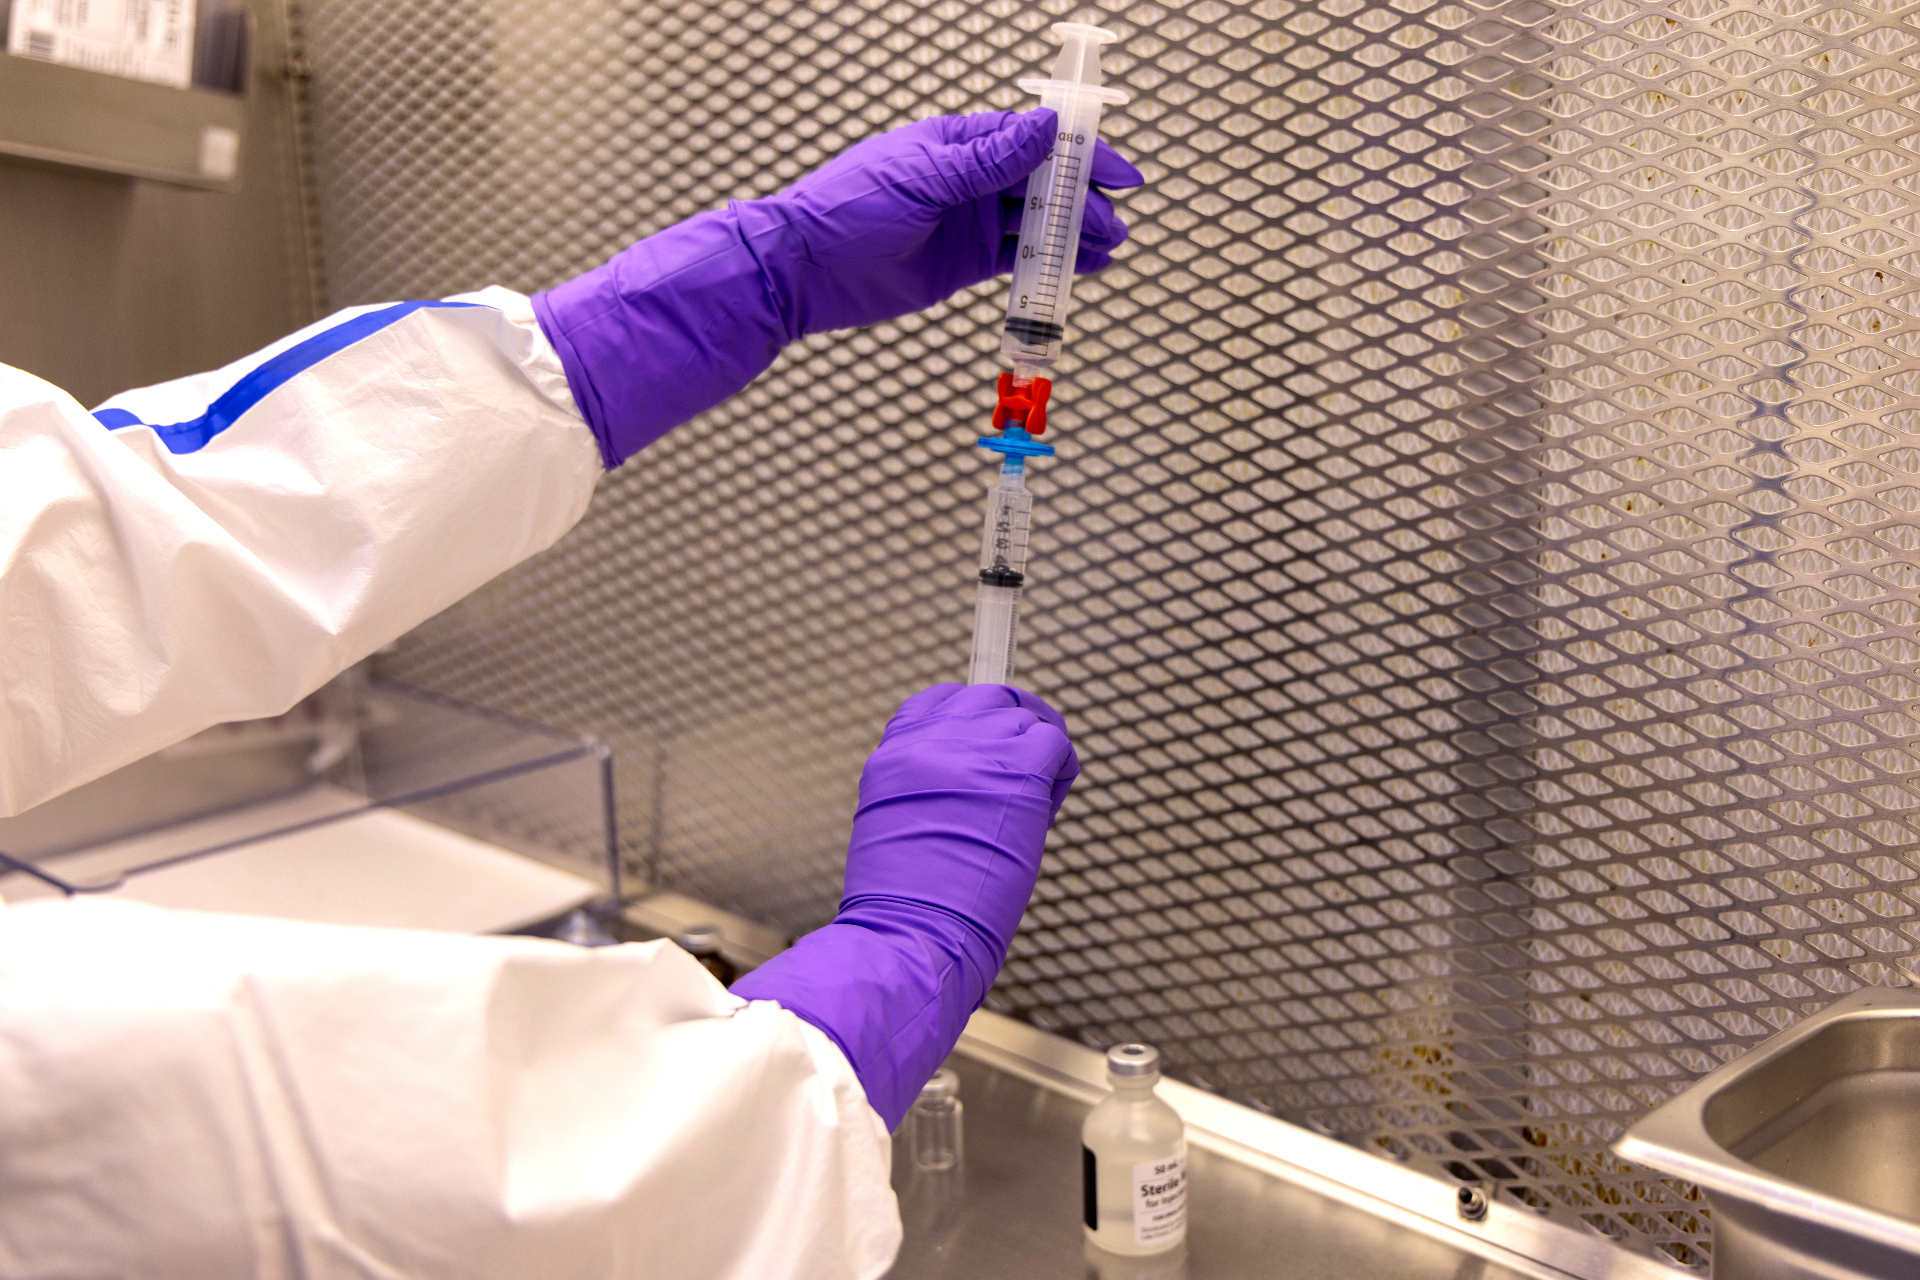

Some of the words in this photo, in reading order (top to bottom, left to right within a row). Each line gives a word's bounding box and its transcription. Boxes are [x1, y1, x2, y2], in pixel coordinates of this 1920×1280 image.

[1058, 131, 1074, 143] BD
[1030, 196, 1044, 210] 15
[1021, 245, 1035, 260] 10
[1019, 295, 1029, 309] 5
[1141, 1176, 1180, 1197] Sterile
